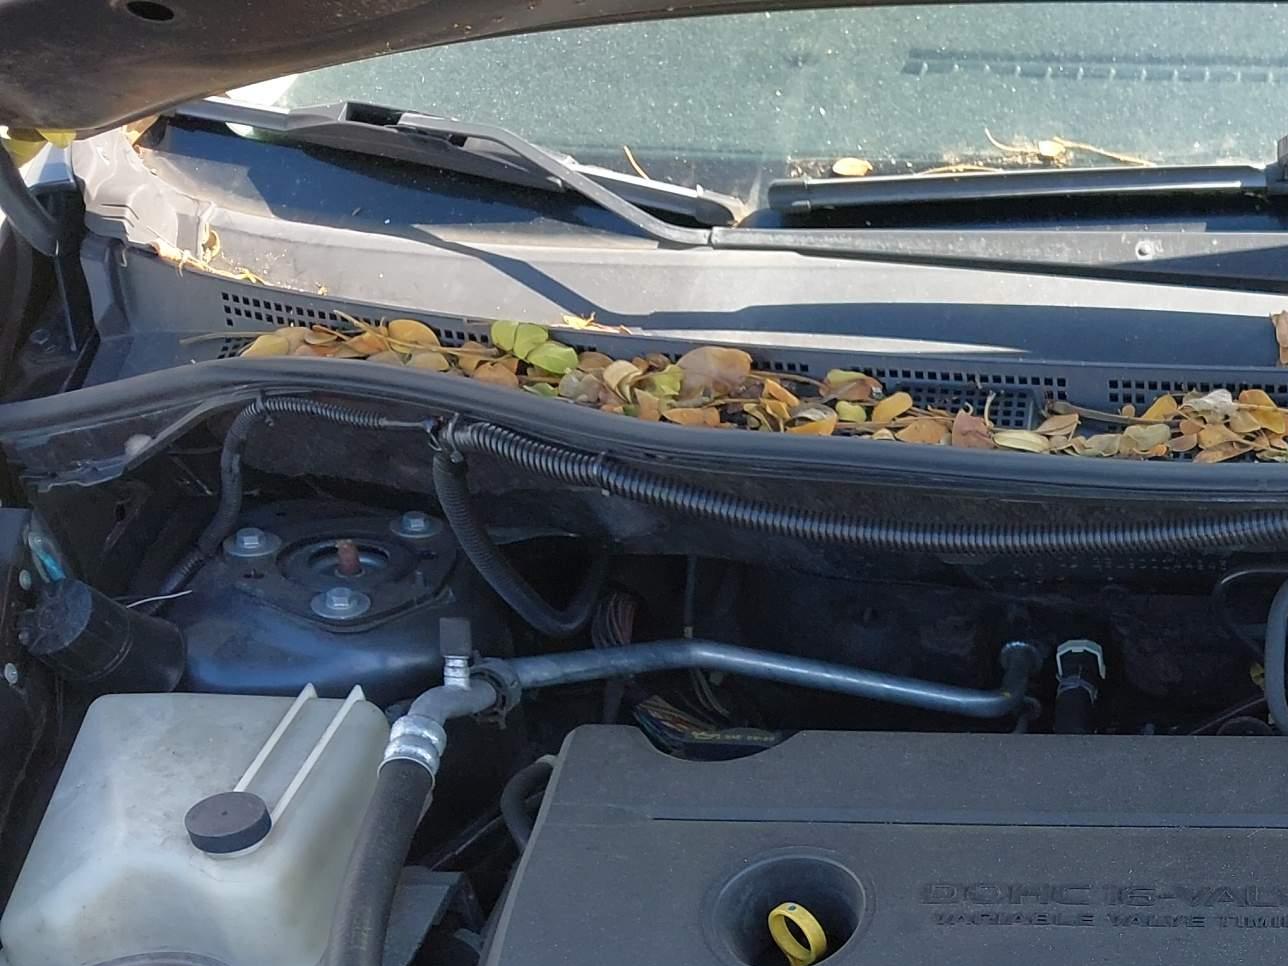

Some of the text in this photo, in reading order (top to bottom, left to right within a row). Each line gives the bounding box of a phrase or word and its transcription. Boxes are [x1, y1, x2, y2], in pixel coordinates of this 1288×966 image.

[920, 883, 1092, 905] DOHC
[934, 911, 1096, 927] VARIABLE
[1106, 912, 1206, 928] VALVE
